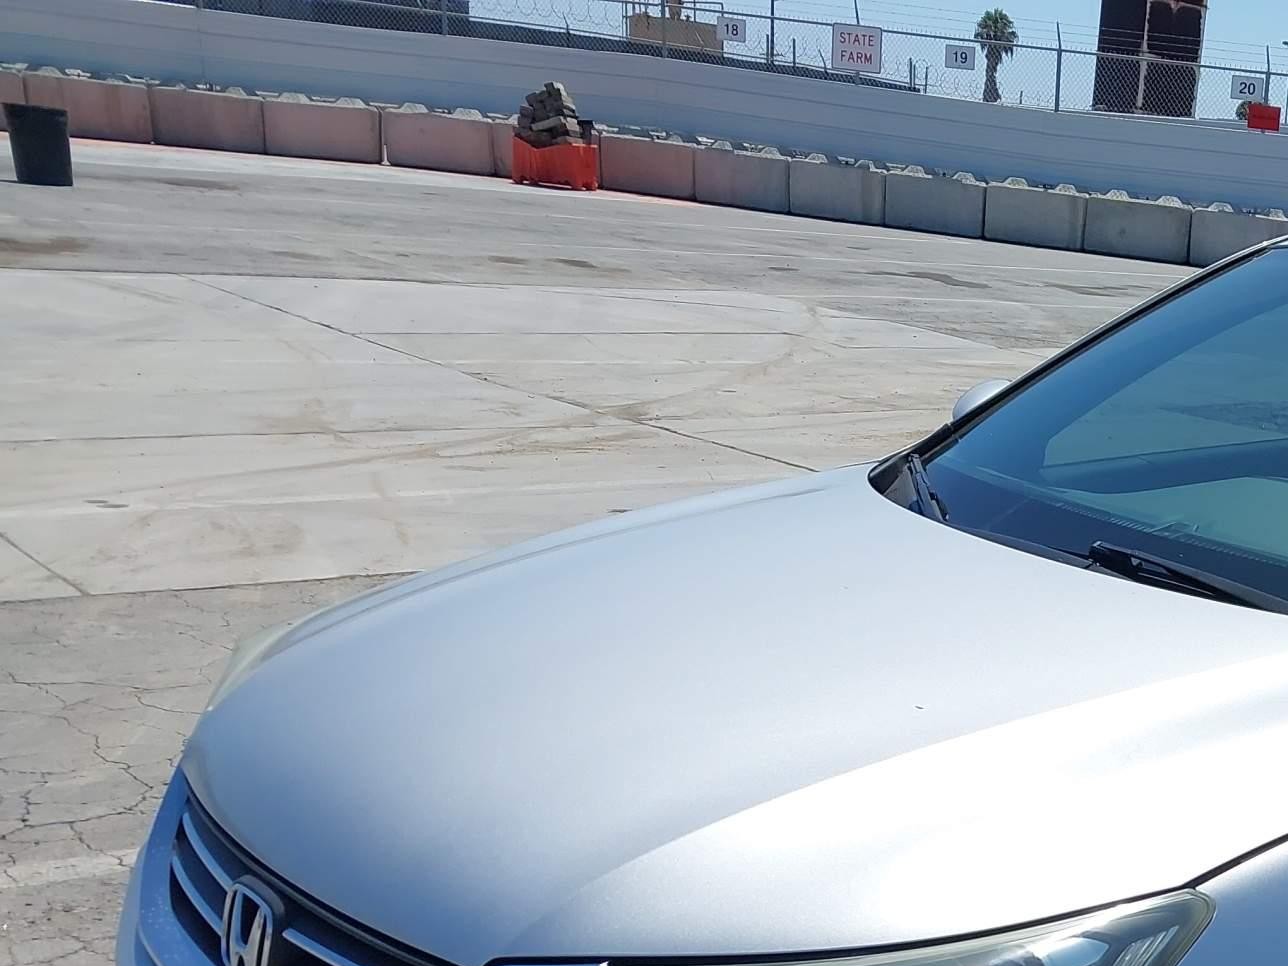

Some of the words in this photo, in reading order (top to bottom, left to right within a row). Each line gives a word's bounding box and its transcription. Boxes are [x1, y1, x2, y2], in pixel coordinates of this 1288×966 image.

[724, 23, 739, 36] 18
[839, 31, 875, 47] STATE
[840, 50, 873, 65] FARM
[952, 51, 968, 64] 19
[1239, 81, 1256, 96] 20
